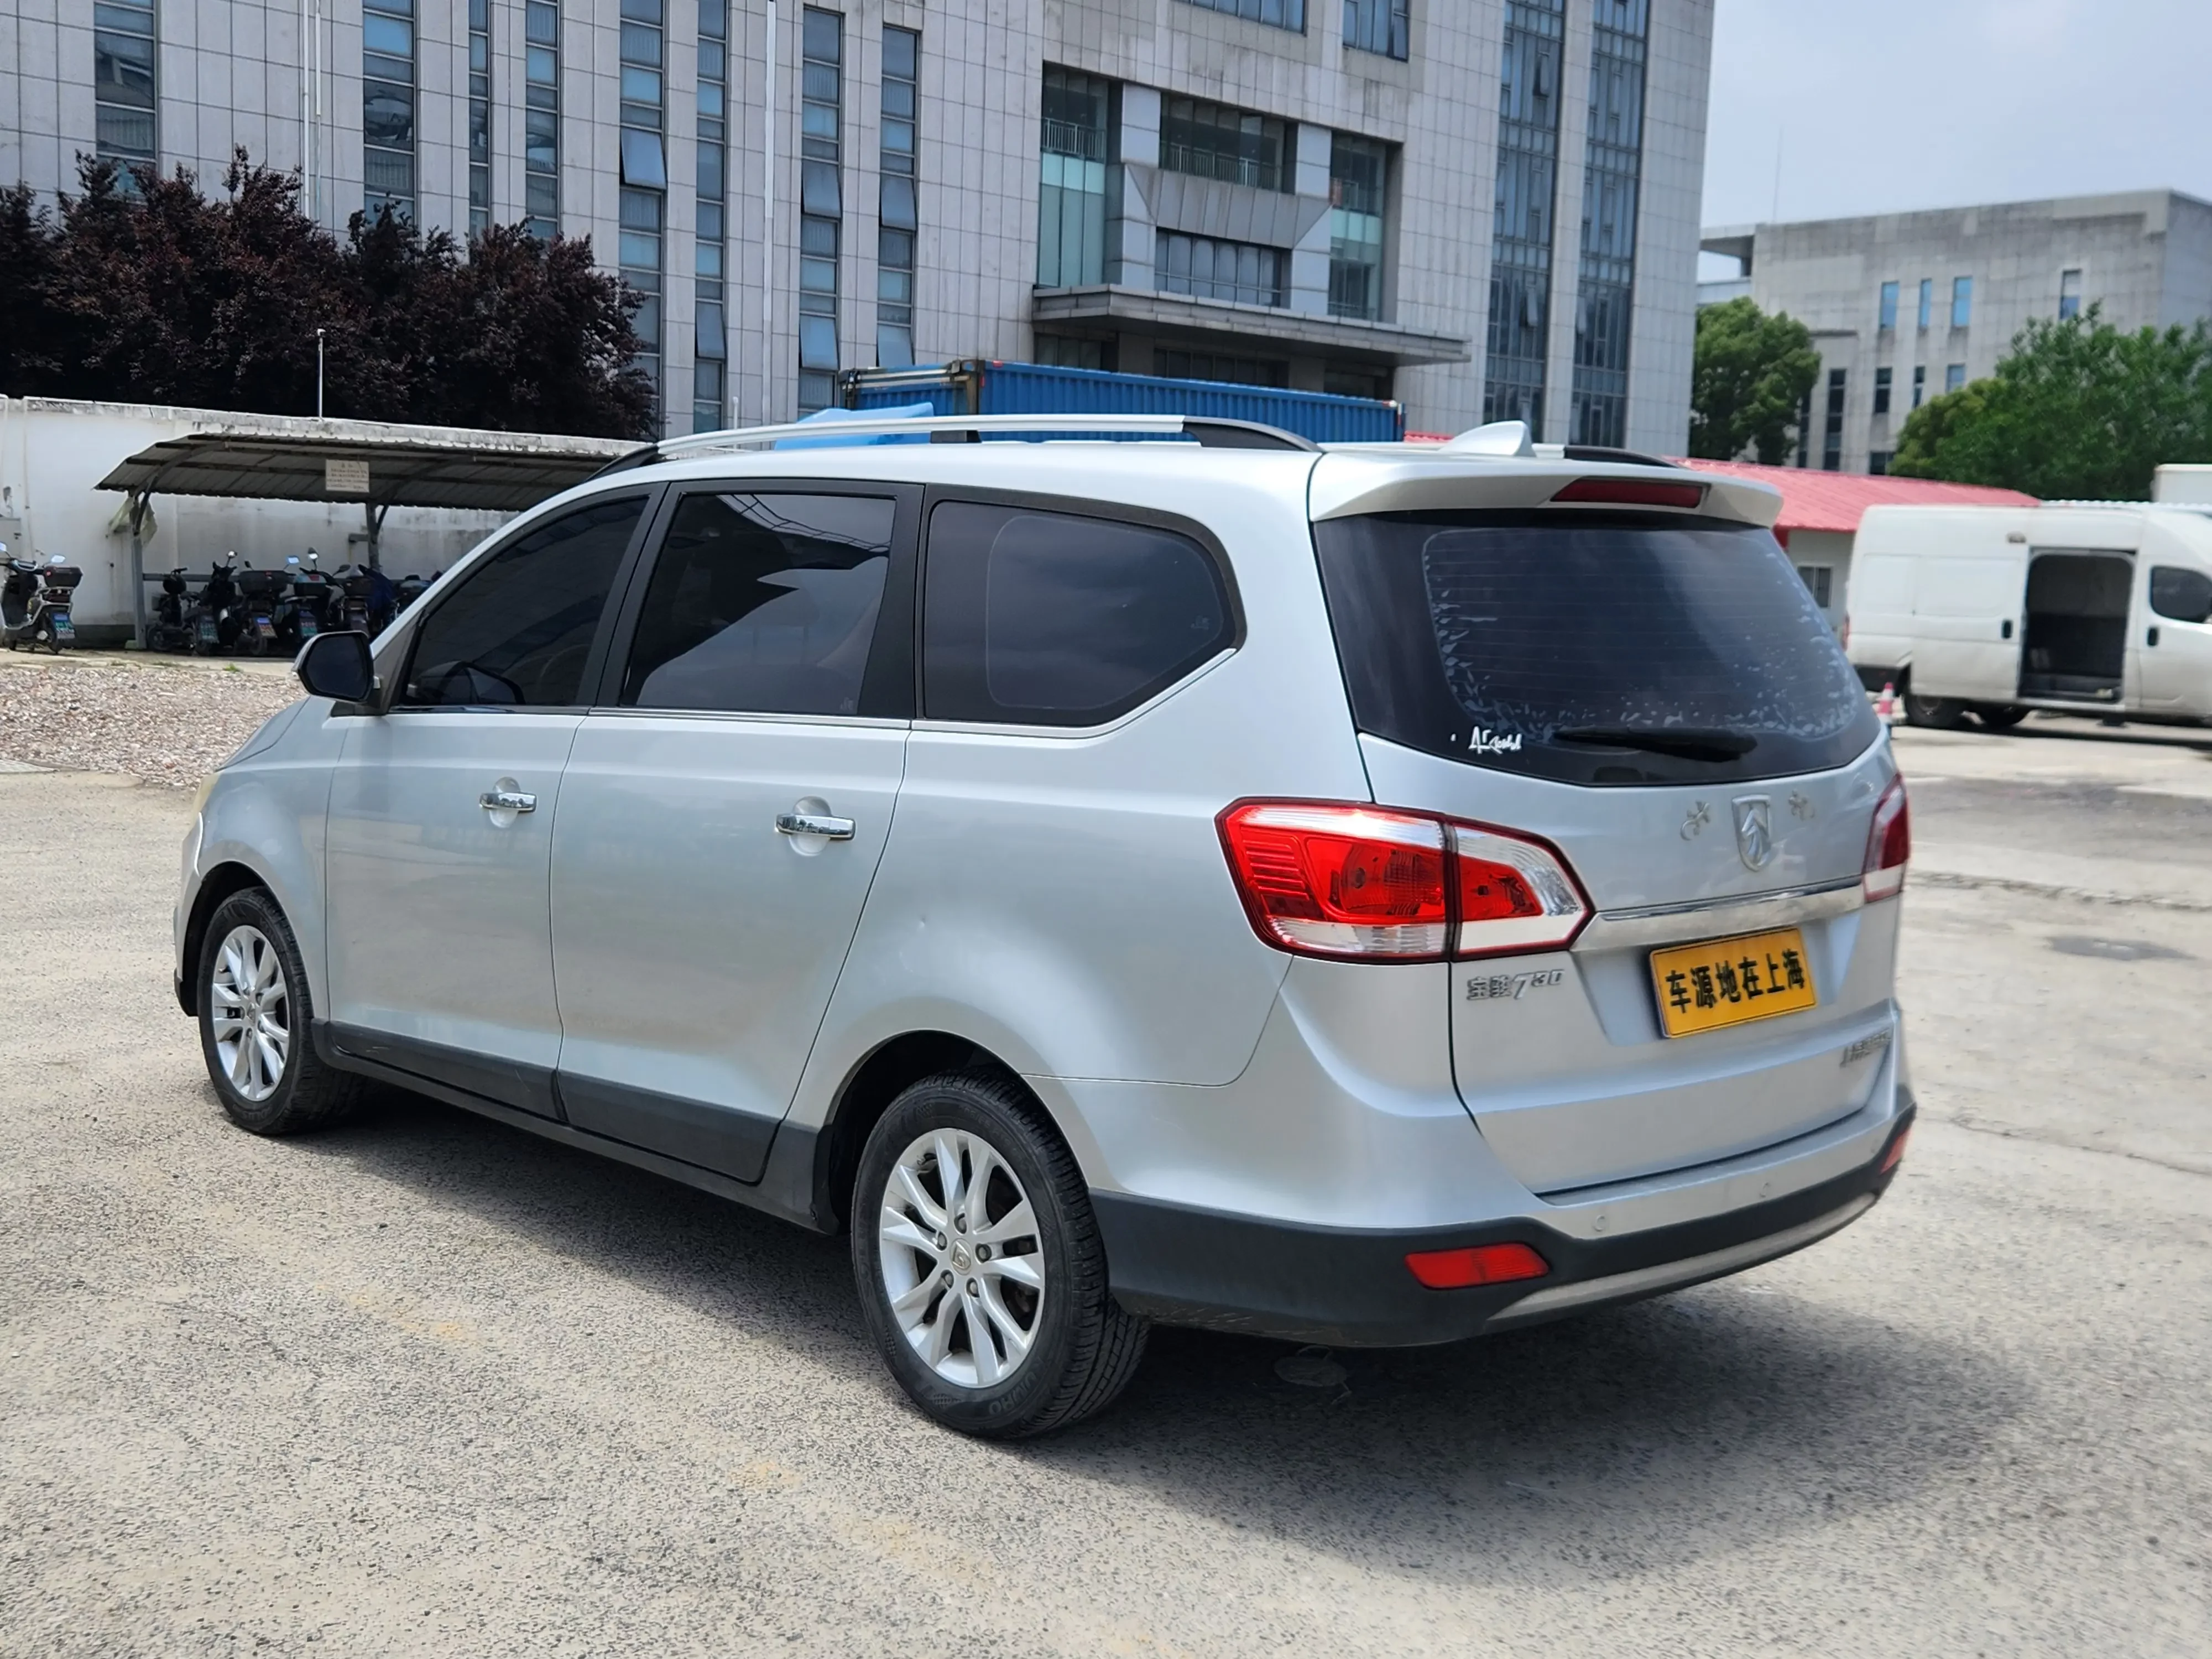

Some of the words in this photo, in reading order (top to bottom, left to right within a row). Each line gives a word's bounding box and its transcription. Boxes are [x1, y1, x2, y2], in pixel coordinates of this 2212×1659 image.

[1665, 948, 1804, 1014] 车源地在上海
